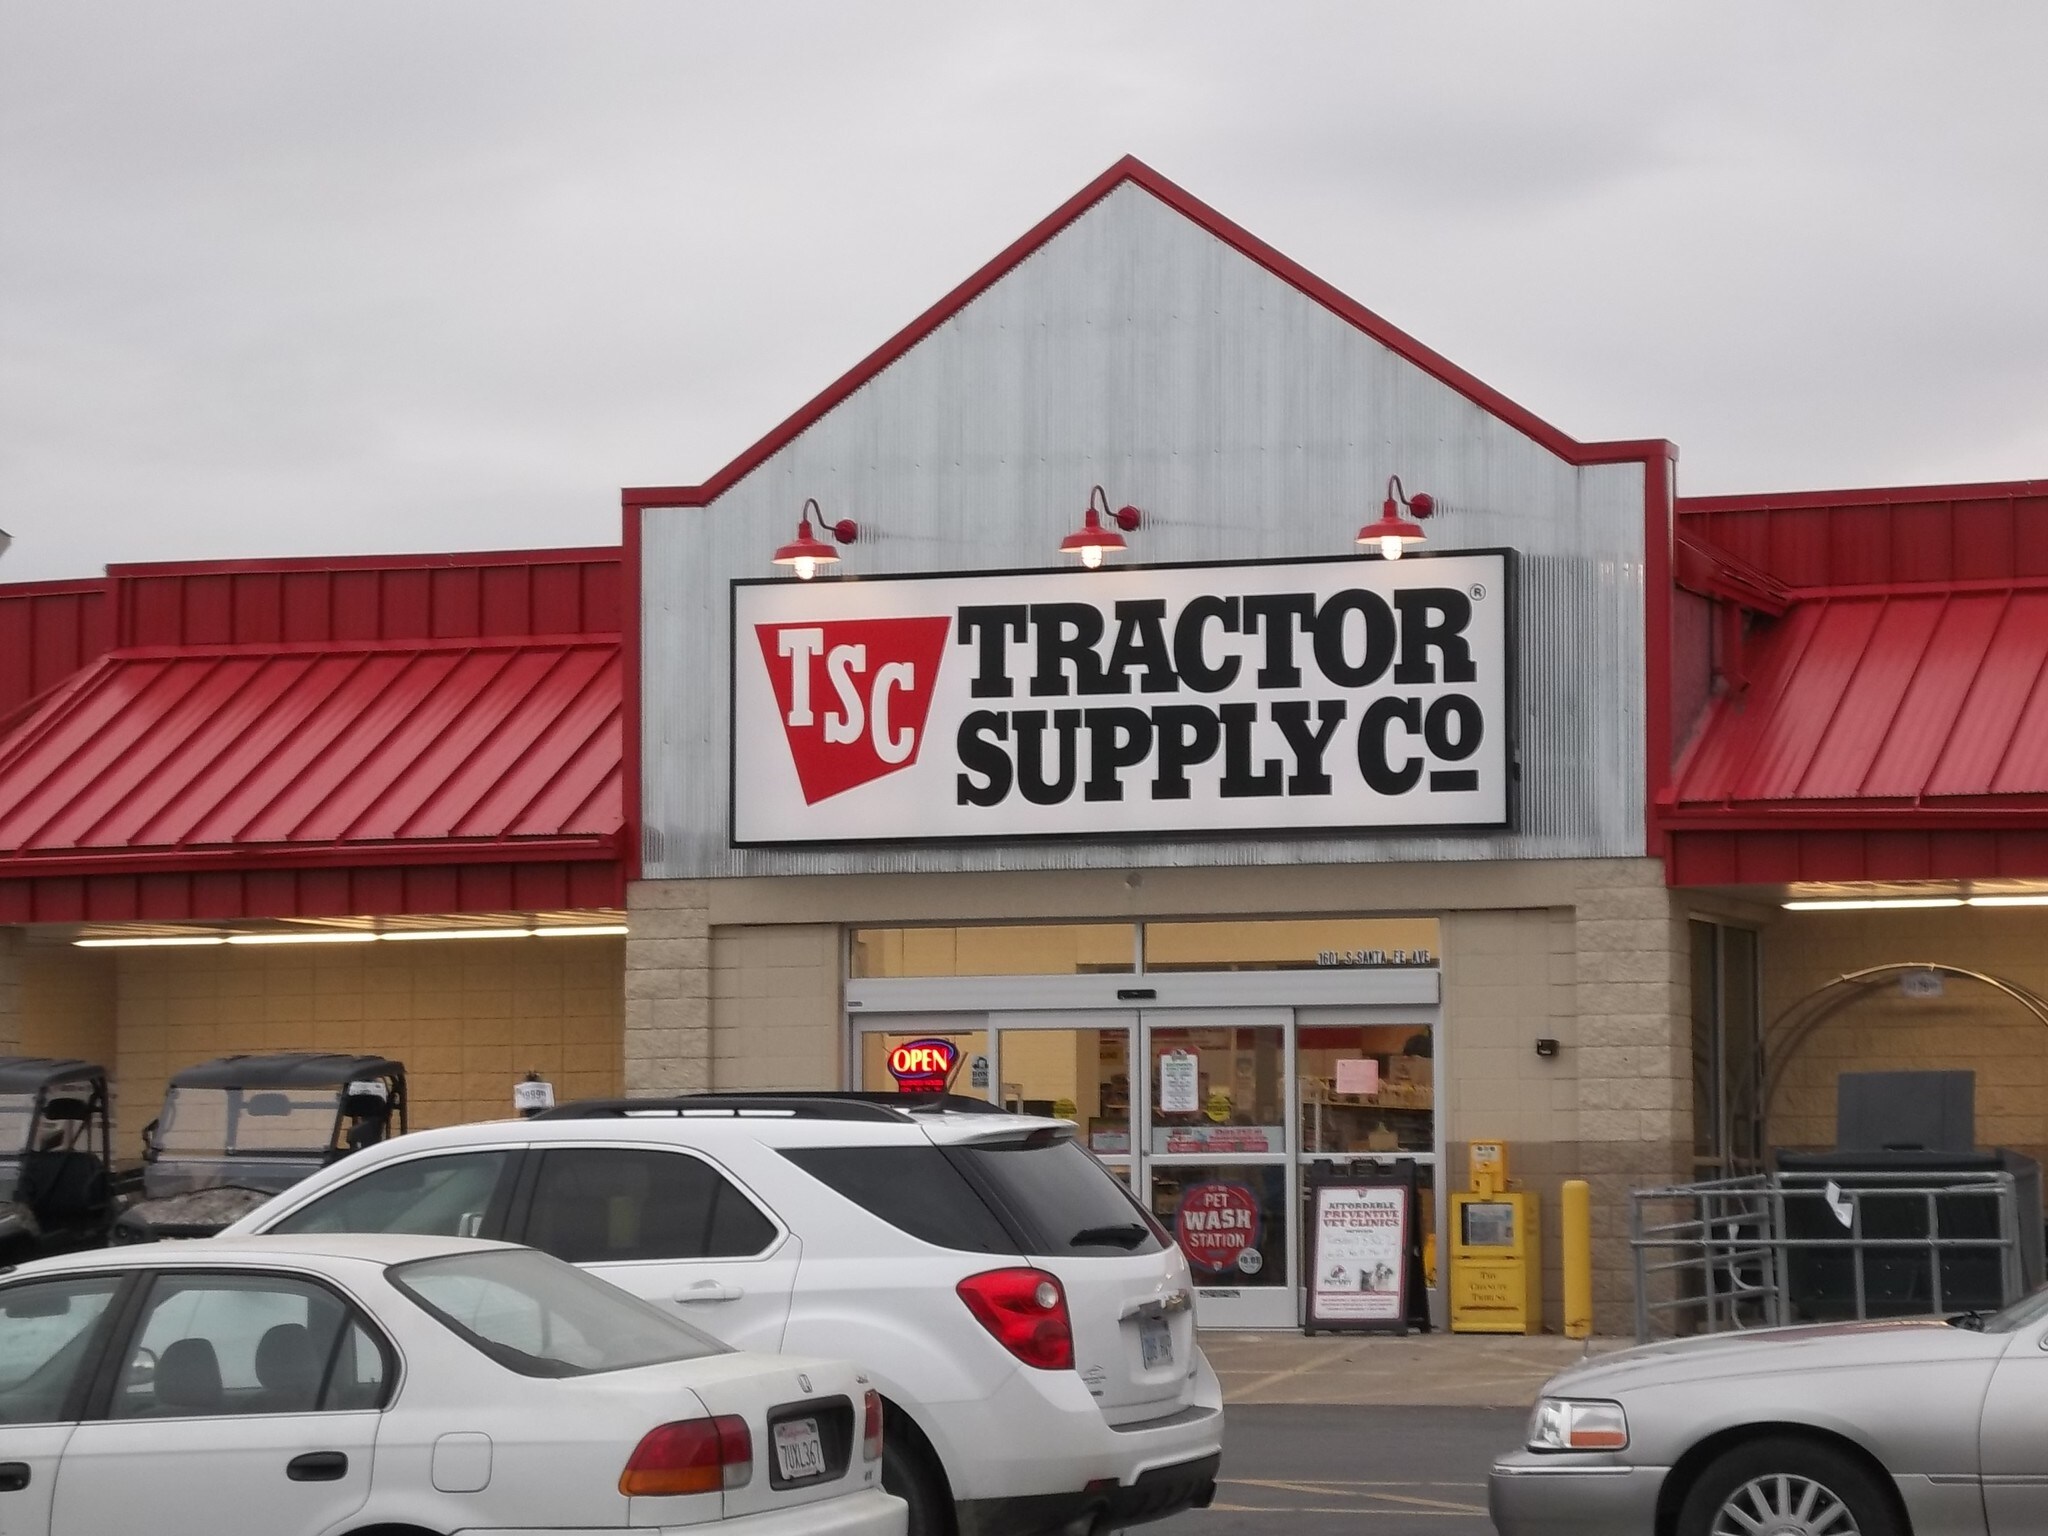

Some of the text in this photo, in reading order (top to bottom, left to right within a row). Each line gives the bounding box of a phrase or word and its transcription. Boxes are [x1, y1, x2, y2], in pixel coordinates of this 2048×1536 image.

[957, 587, 1478, 698] TRACTOR
[778, 627, 915, 764] TSC
[956, 699, 1347, 807] SUPPLY
[1345, 950, 1353, 965] S
[1355, 950, 1388, 965] SANTA
[1412, 950, 1431, 964] AVE
[893, 1048, 948, 1072] OPEN
[1204, 1193, 1229, 1207] PET
[1183, 1209, 1252, 1231] WASH
[1322, 1219, 1400, 1228] VET CLINICS
[1323, 1210, 1400, 1219] PREVENTIVE
[1189, 1233, 1245, 1248] STATION
[780, 1439, 821, 1471] 7UXL367
